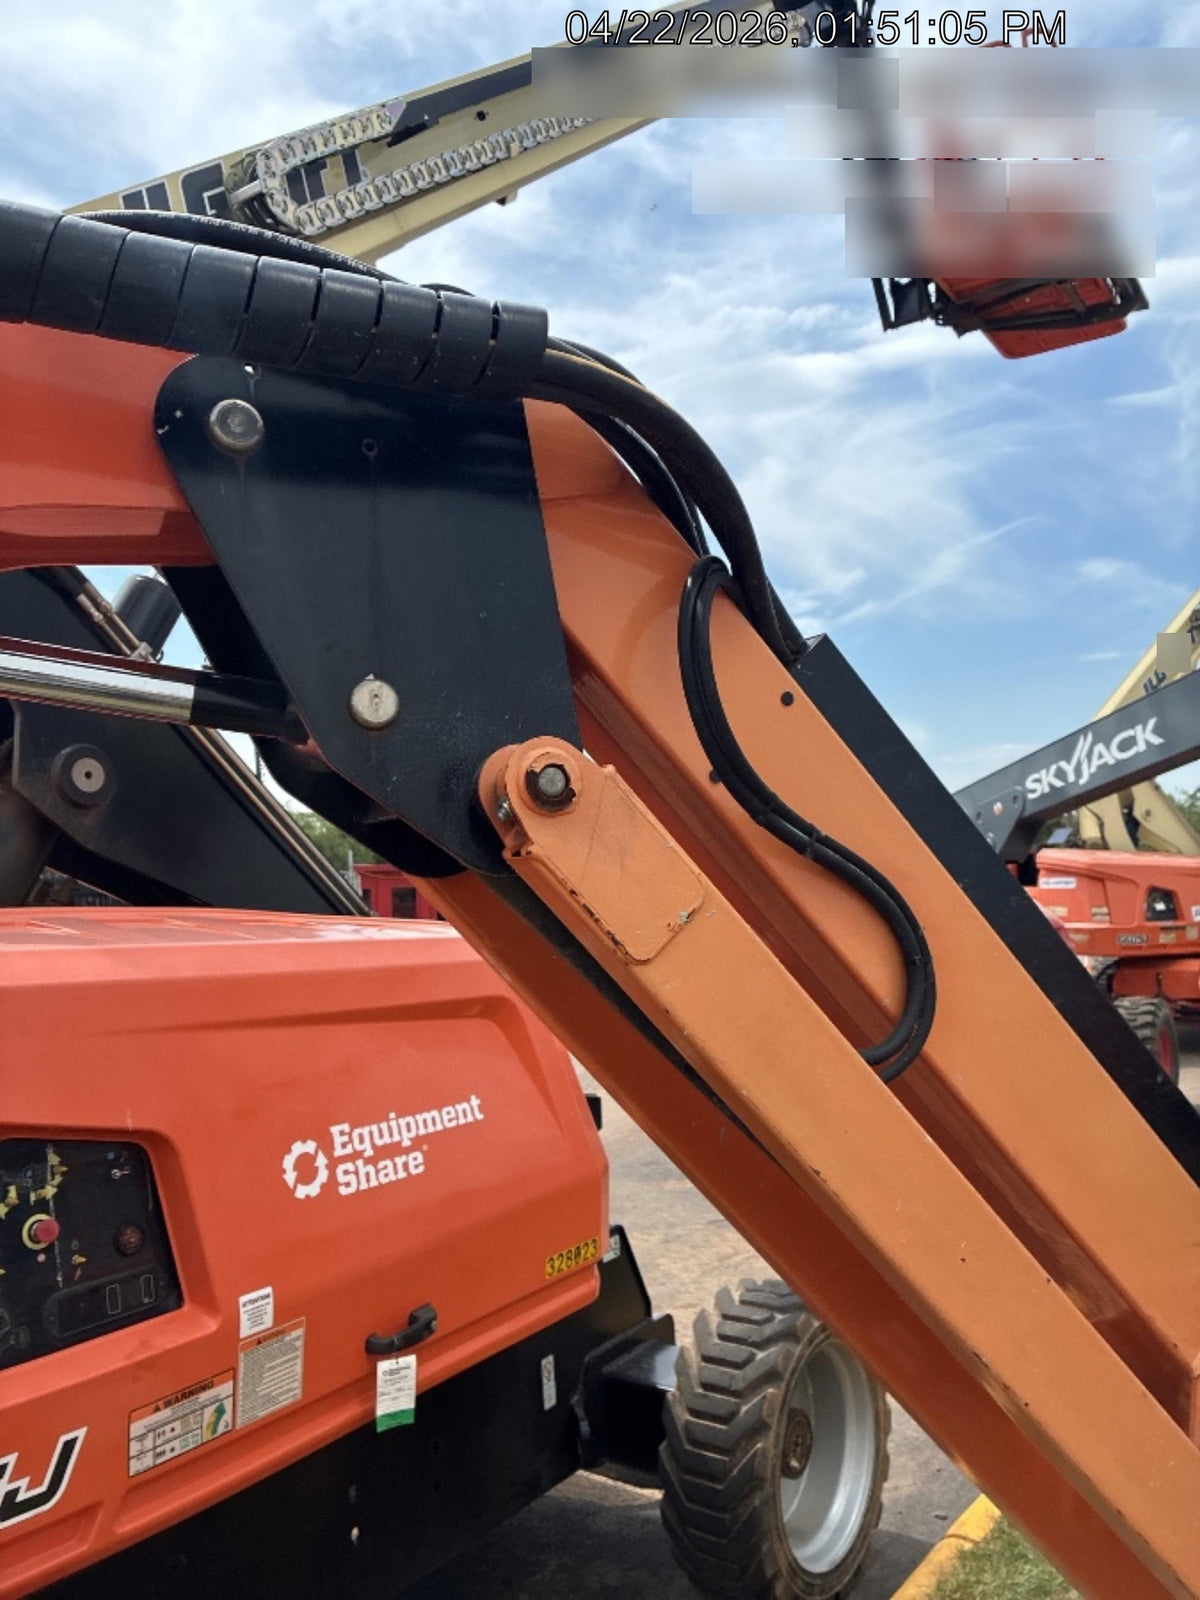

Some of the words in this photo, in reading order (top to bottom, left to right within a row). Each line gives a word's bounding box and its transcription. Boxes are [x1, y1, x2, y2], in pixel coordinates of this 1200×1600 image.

[1025, 716, 1165, 799] SKYJACK
[329, 1094, 484, 1157] Equipment
[335, 1150, 426, 1196] Share
